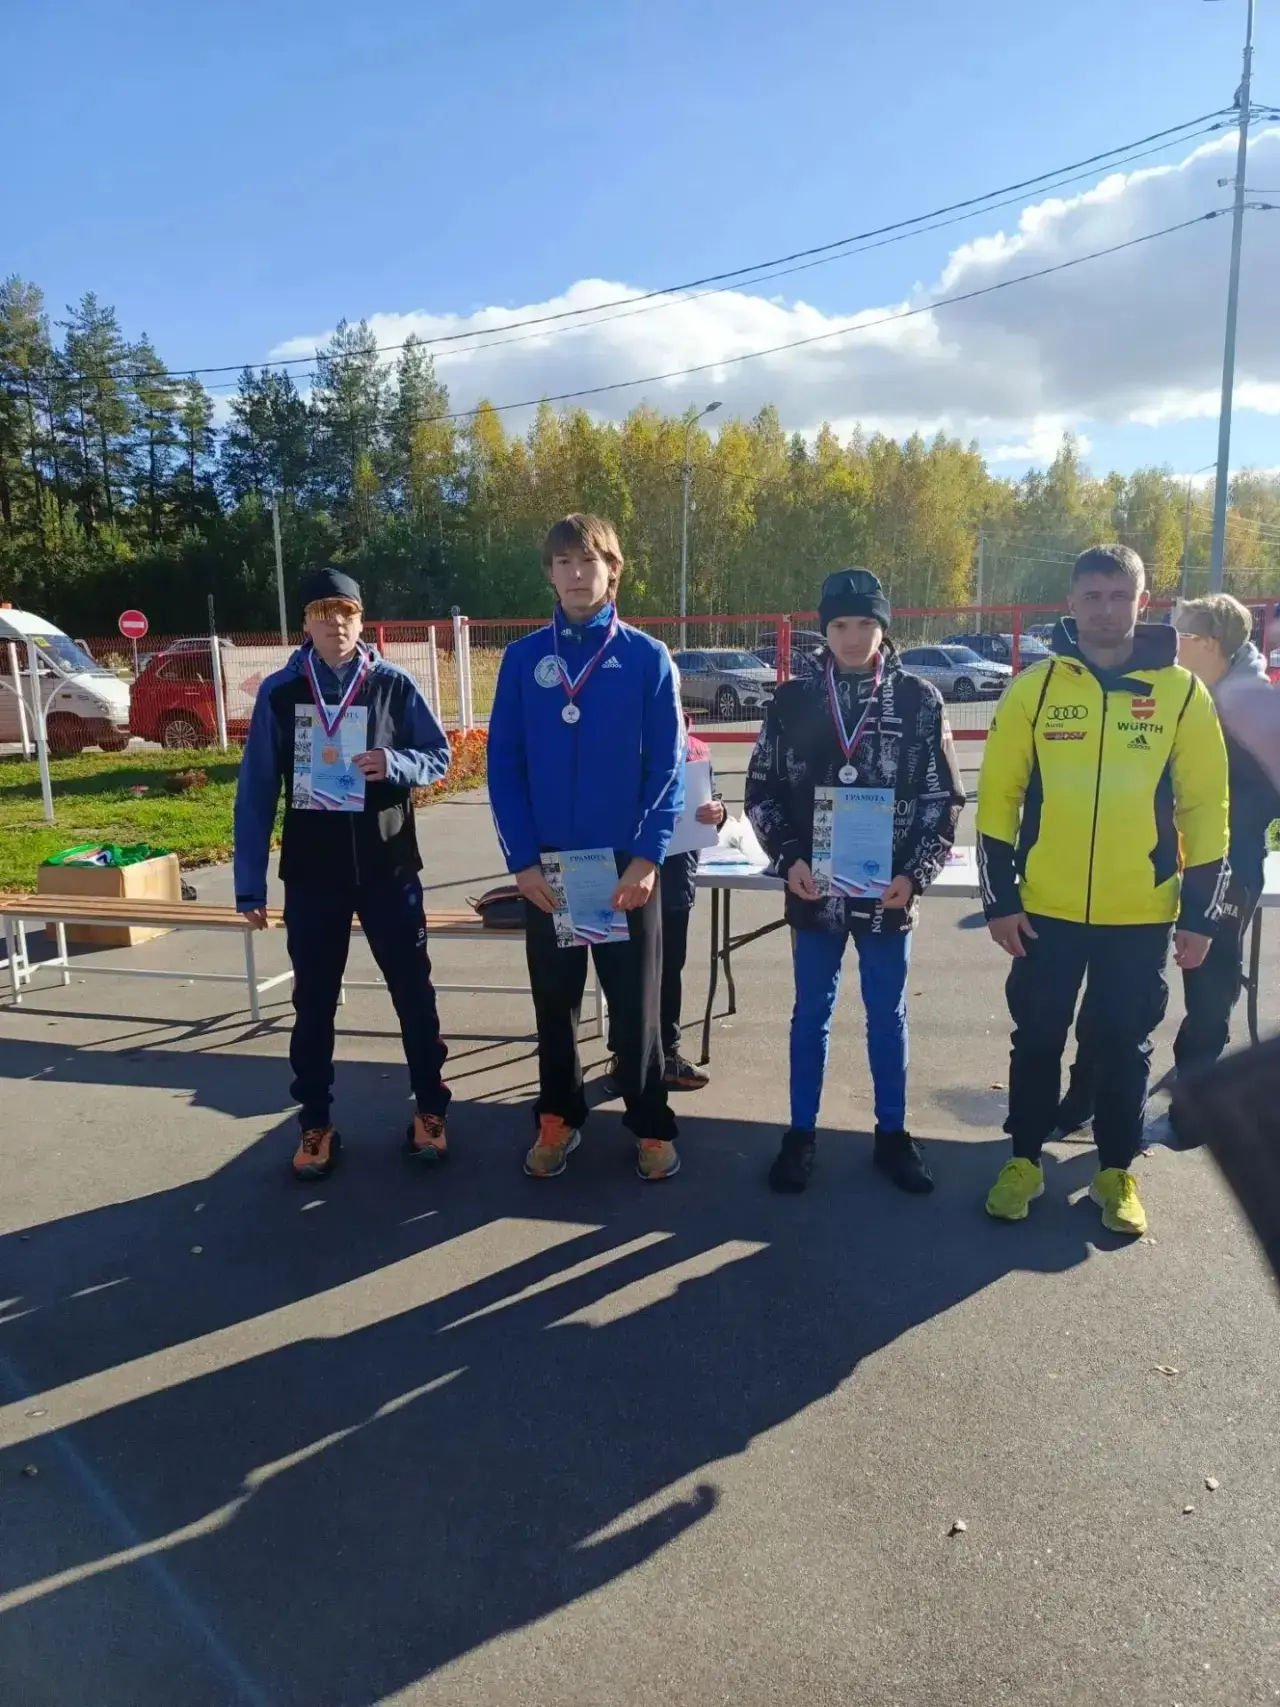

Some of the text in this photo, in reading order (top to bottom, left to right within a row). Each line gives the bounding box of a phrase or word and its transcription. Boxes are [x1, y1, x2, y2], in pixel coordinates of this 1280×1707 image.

[1117, 721, 1164, 734] WÜRTH
[845, 794, 886, 803] ГРАМОТА
[570, 854, 607, 862] ГРАМОТА
